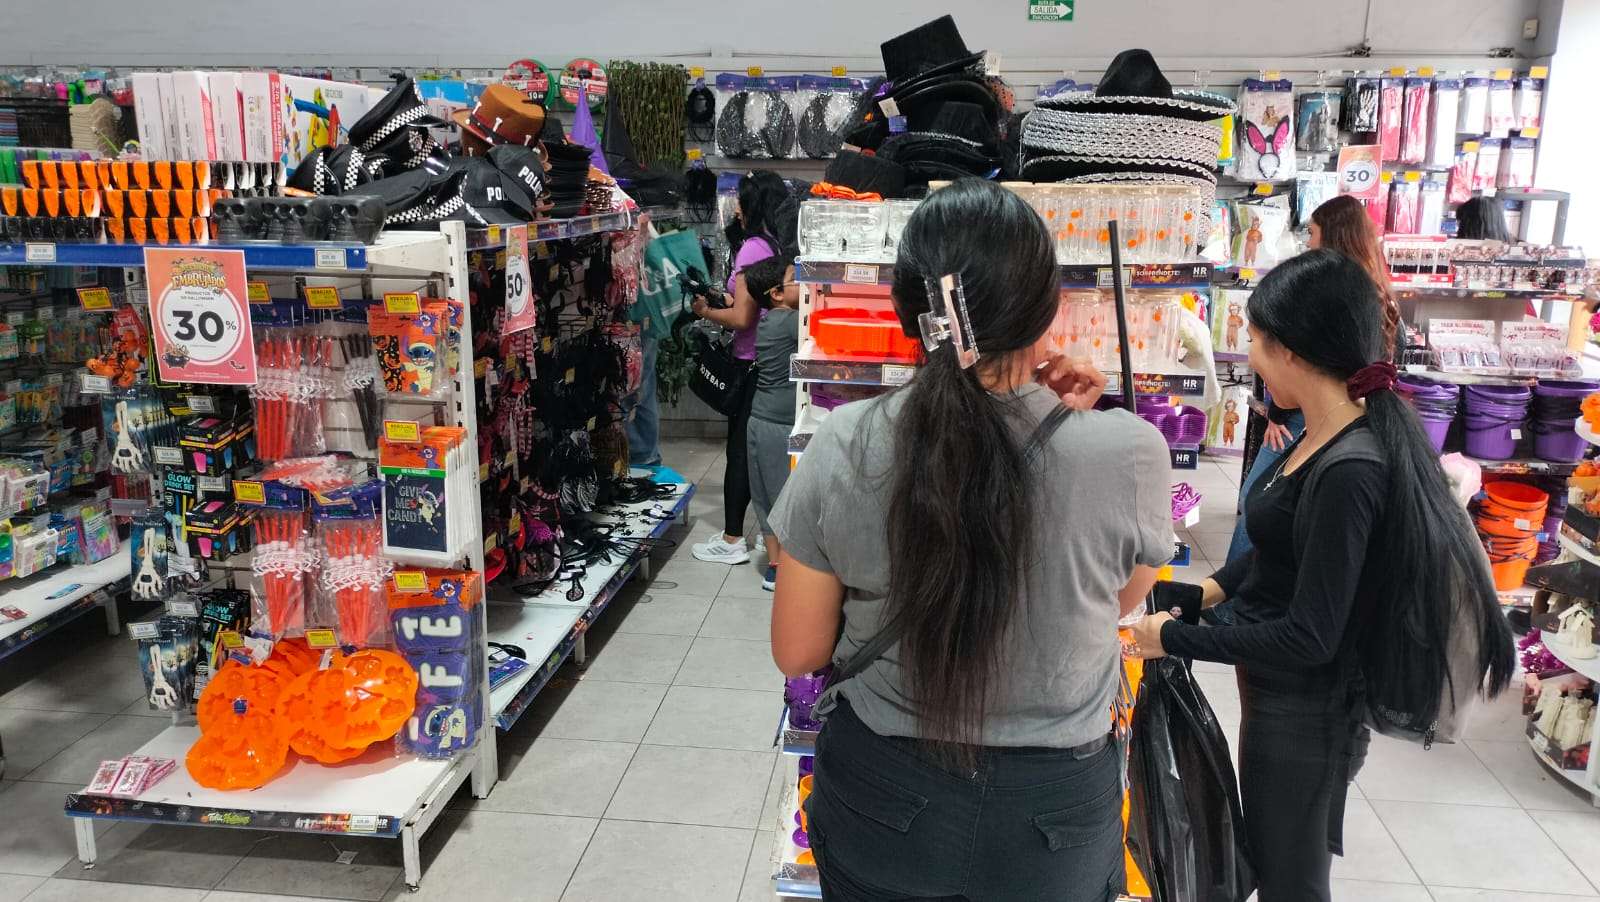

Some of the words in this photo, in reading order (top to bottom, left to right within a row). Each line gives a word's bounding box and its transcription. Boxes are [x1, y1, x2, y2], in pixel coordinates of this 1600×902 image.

[1193, 267, 1208, 276] HR
[1183, 379, 1197, 388] HR
[1176, 454, 1190, 463] HR
[167, 473, 192, 484] GLOW
[183, 482, 195, 491] SET
